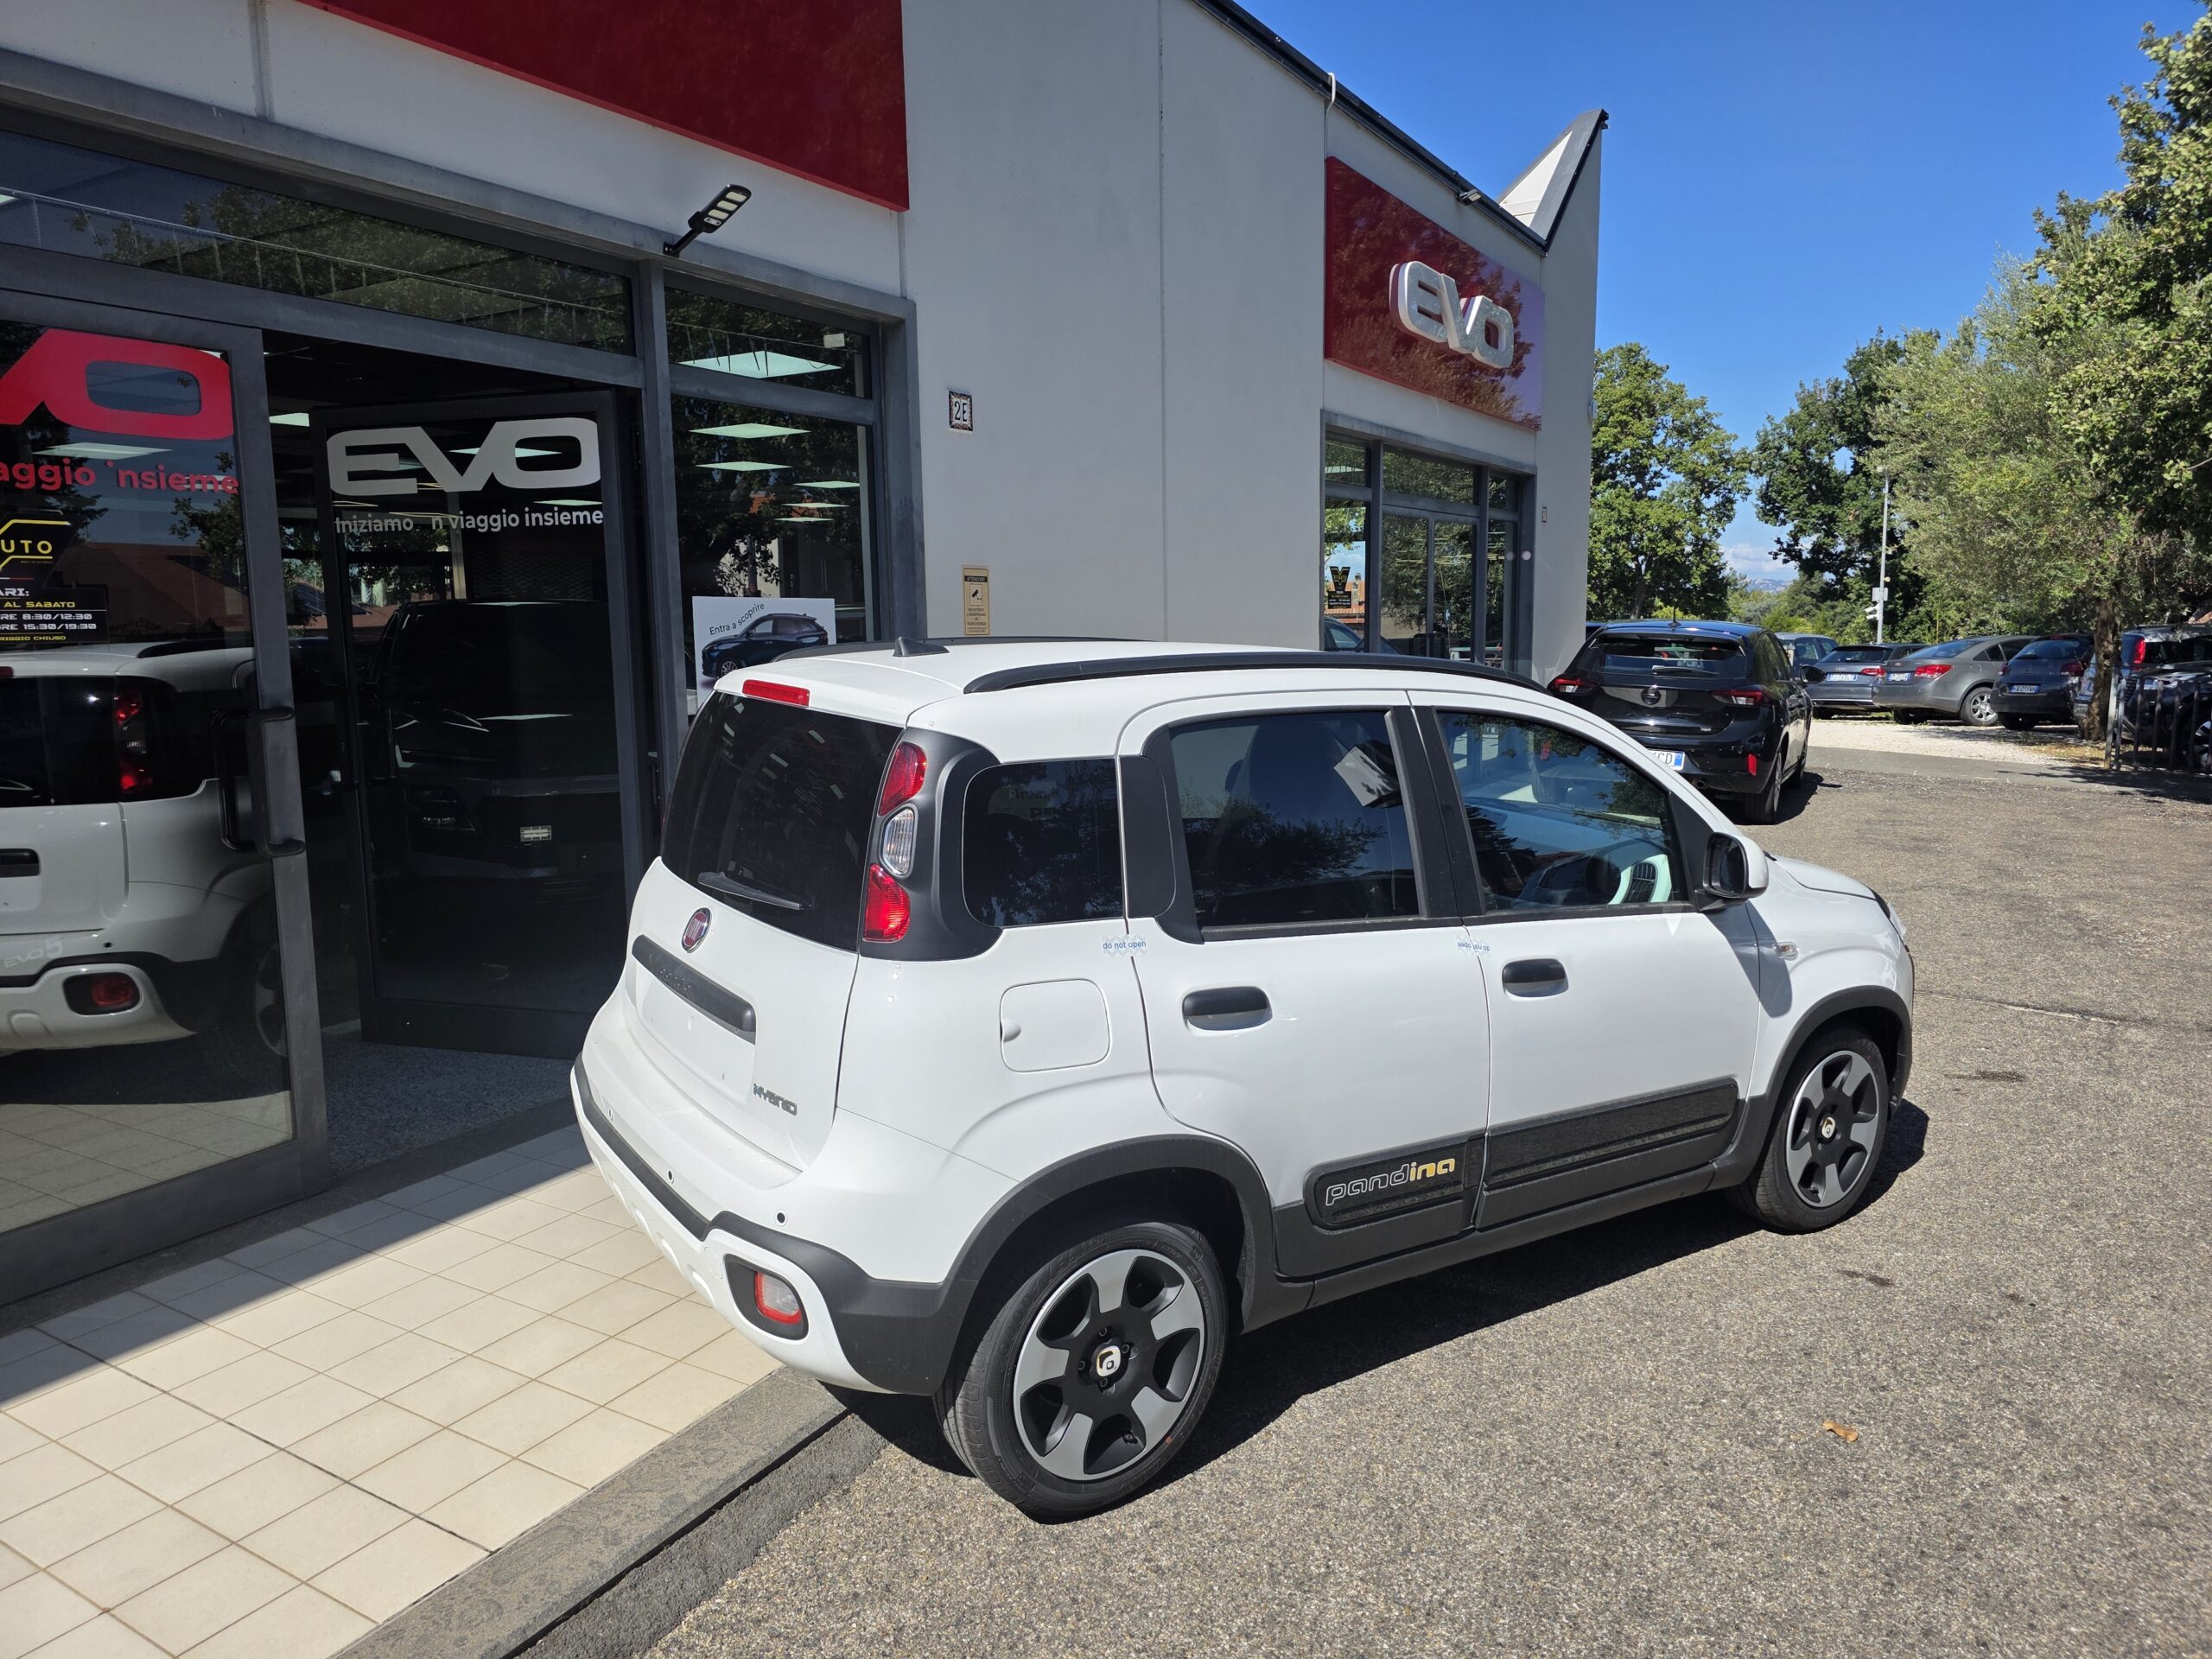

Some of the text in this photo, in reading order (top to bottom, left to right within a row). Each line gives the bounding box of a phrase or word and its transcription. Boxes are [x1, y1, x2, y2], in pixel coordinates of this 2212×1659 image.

[1395, 260, 1514, 369] EVO
[954, 400, 968, 423] 2E
[326, 417, 601, 496] EVO
[105, 460, 239, 495] nsieme
[334, 512, 414, 533] Iniziamo
[448, 510, 519, 532] viaggio
[524, 506, 603, 528] insieme
[709, 624, 730, 635] Entra
[738, 603, 765, 626] scoprire
[1128, 941, 1146, 950] open
[753, 1083, 798, 1116] HYBRID
[1325, 1158, 1456, 1207] pandina
